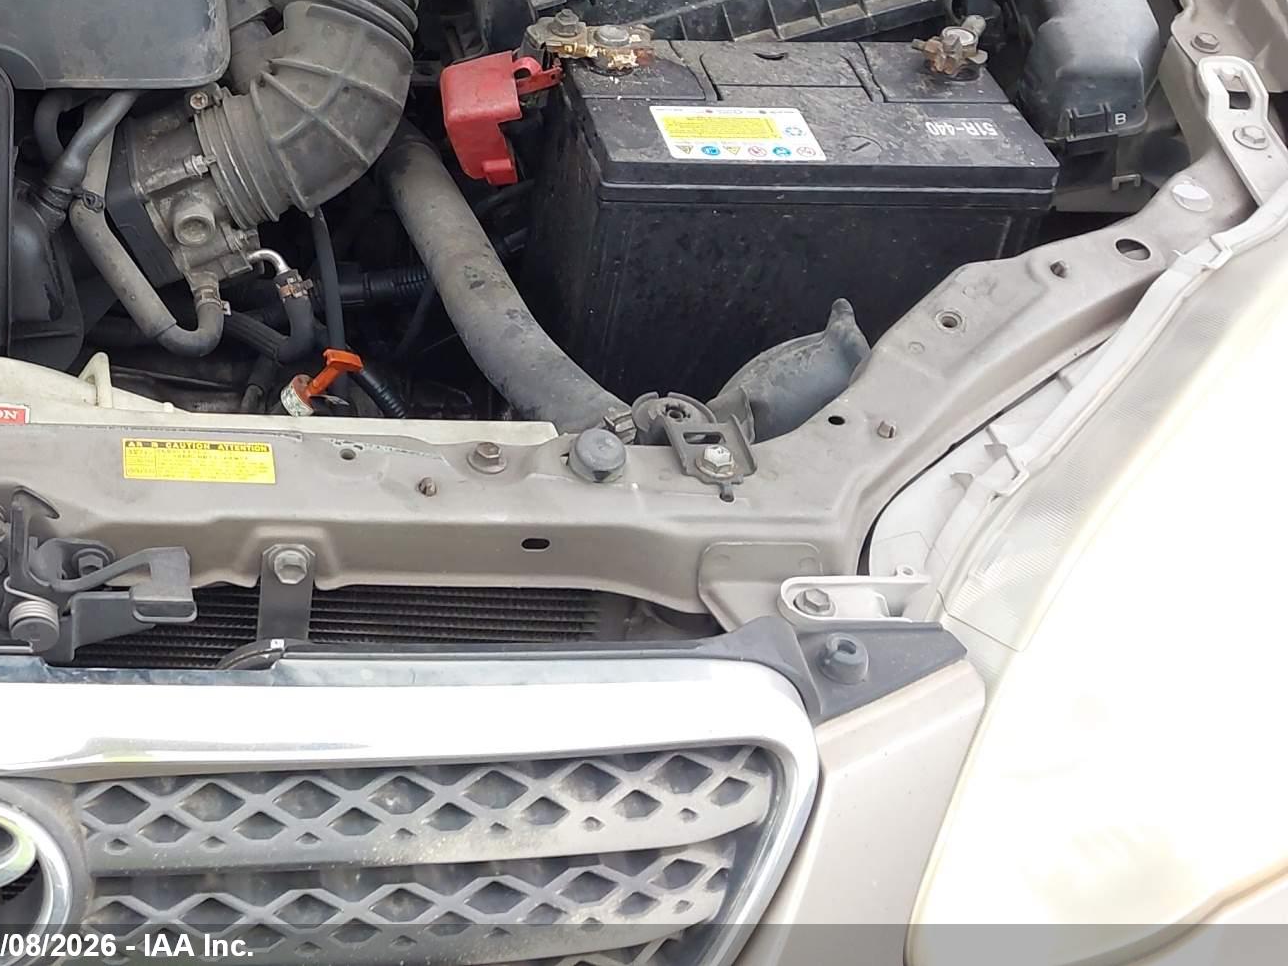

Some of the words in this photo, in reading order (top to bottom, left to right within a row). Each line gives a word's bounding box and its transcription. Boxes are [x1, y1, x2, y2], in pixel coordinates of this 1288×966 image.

[1114, 112, 1127, 126] B
[925, 121, 999, 136] 51R-440
[166, 441, 211, 450] CAUTION
[217, 443, 268, 452] ATTENTION
